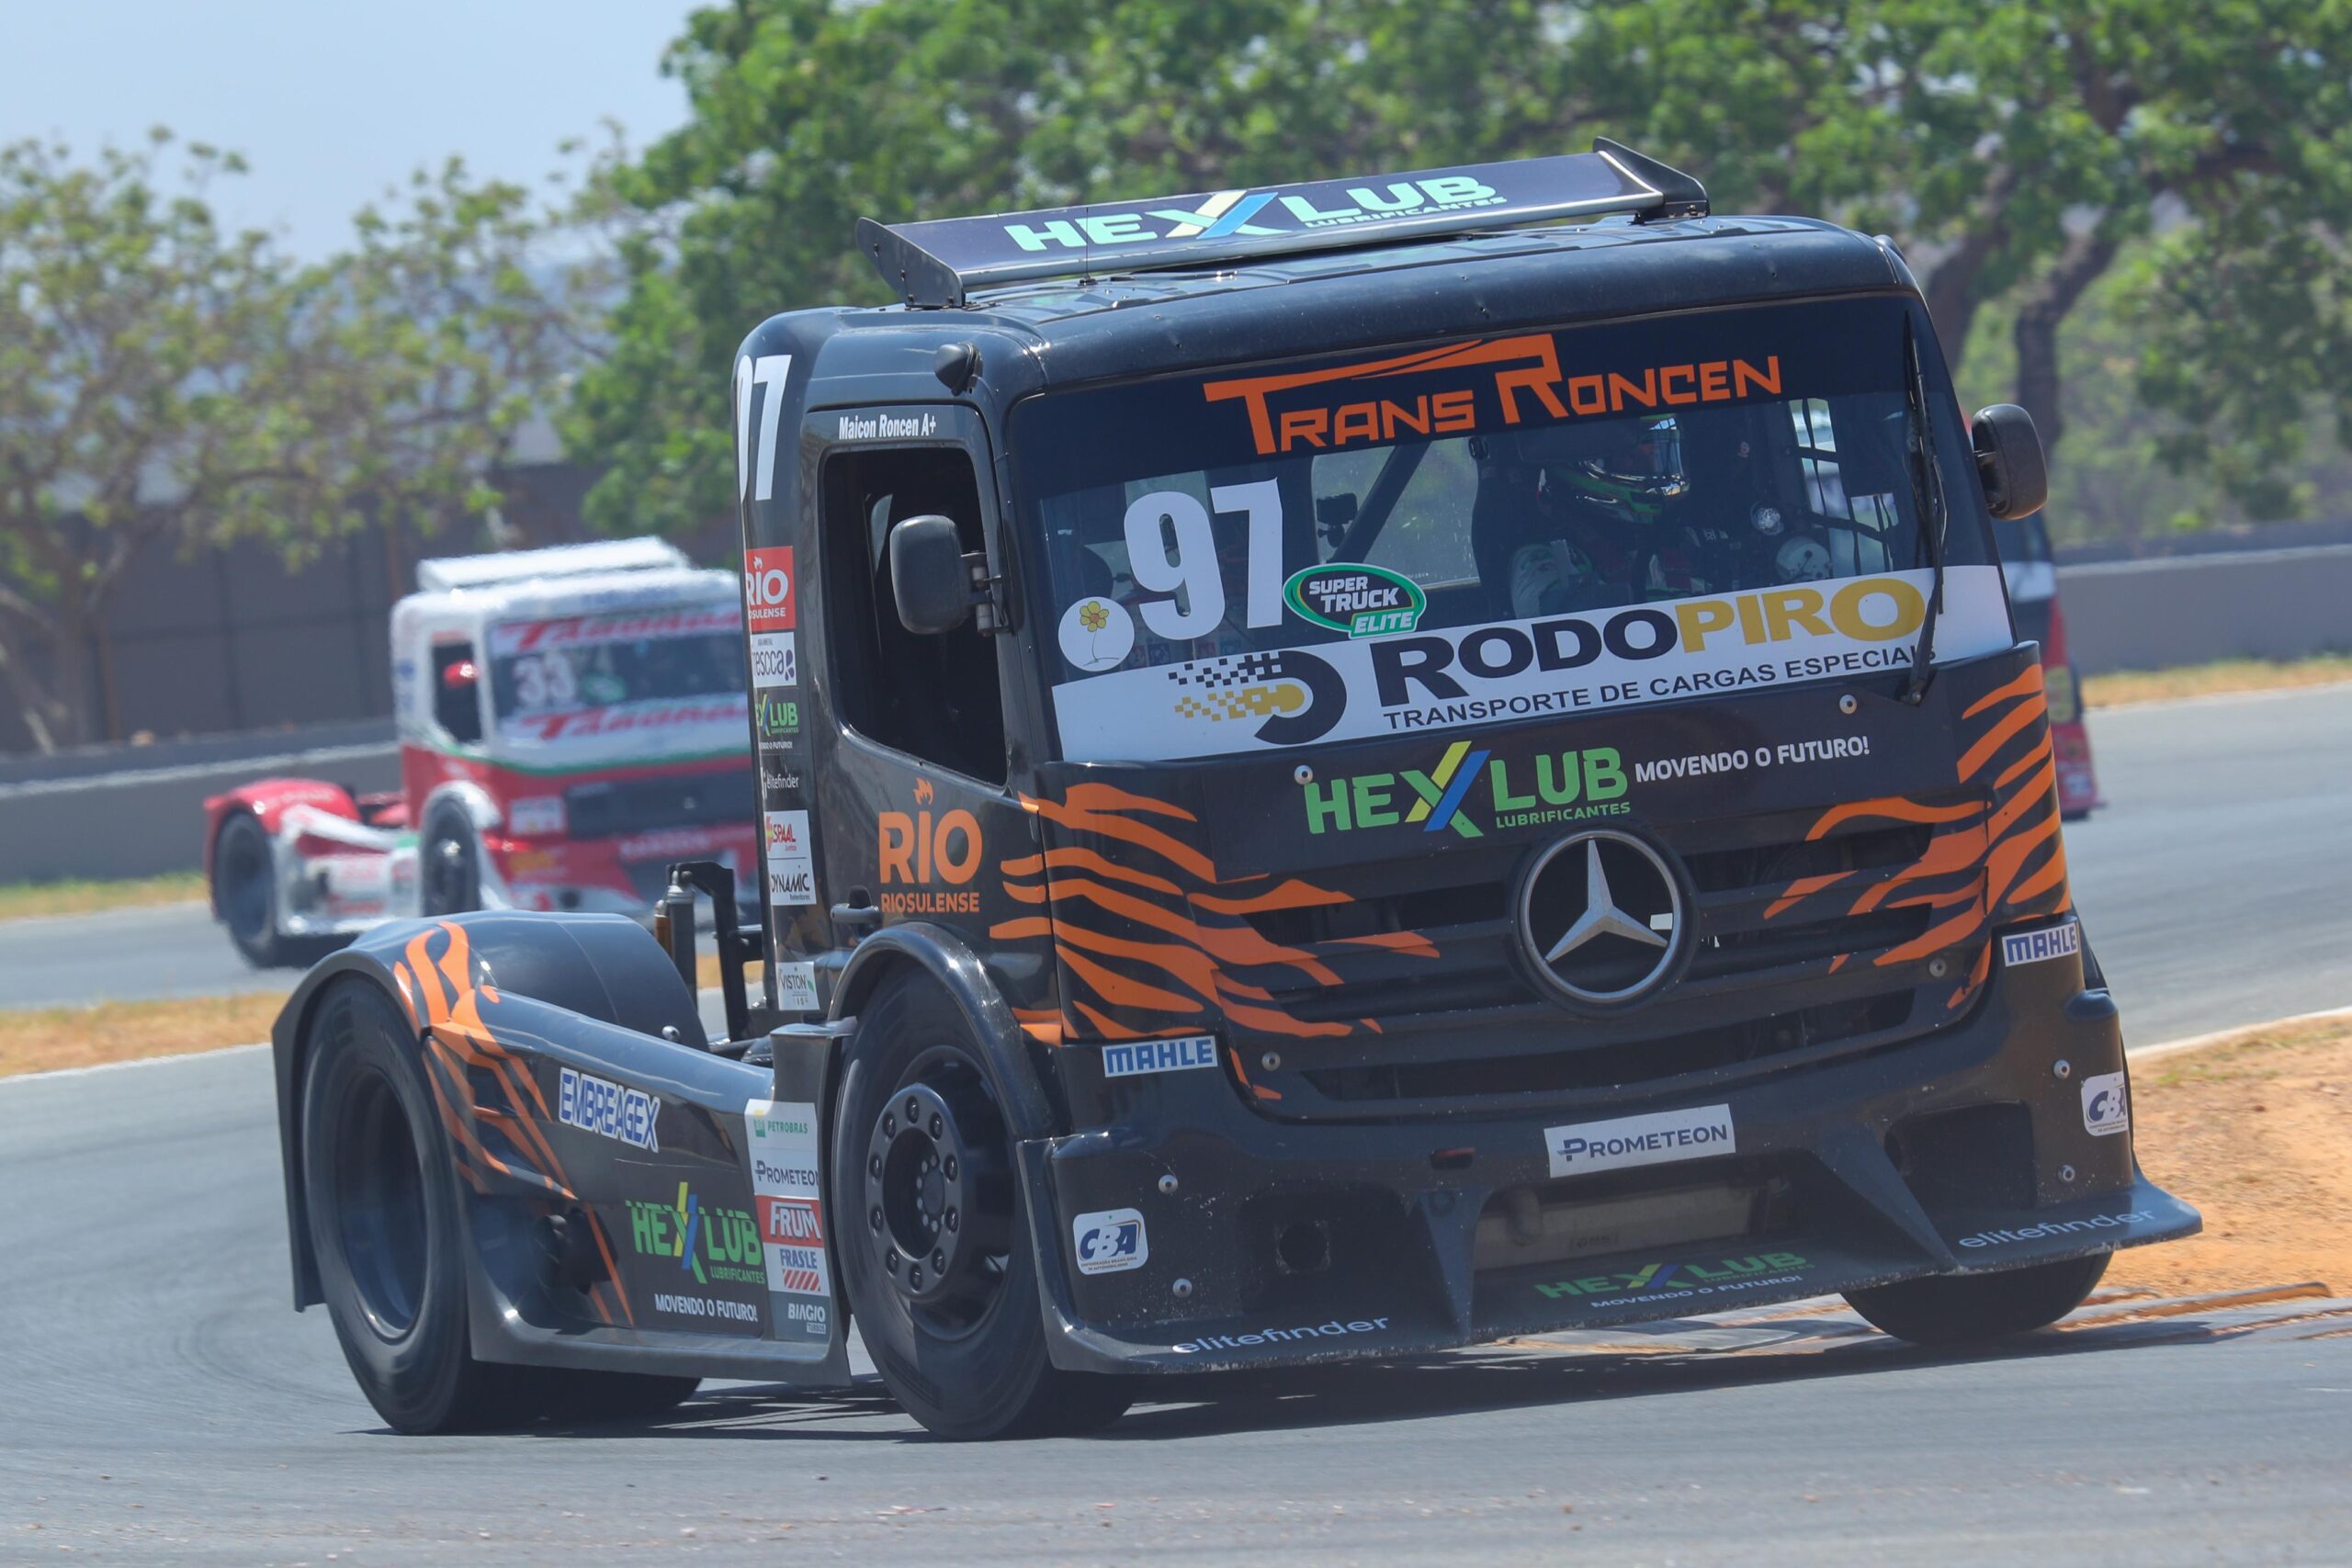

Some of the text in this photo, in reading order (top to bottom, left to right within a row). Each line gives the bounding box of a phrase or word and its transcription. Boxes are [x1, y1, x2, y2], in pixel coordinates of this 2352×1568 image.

[1004, 175, 1497, 252] HEXLUB
[1305, 197, 1508, 228] LUBRIFICANTES
[1203, 333, 1781, 455] TRANS RONCEN
[839, 412, 936, 440] Maicon Roncen A+
[1124, 478, 1283, 640] 97
[1309, 576, 1368, 595] SUPER
[1321, 587, 1399, 614] TRUCK
[1354, 611, 1414, 634] ELITE
[1370, 578, 1926, 707] RODOPIRO
[1383, 688, 1591, 729] TRANSPORTE
[1600, 682, 1640, 703] DE
[1650, 663, 1776, 695] CARGAS
[1304, 735, 1871, 838] HEXLUB MOVENDO O FUTURO!
[1496, 802, 1631, 829] LUBRIFICANTES
[878, 809, 983, 885] RIO
[880, 892, 980, 913] RIOSULENSE
[2006, 925, 2077, 963] MAHLE
[1105, 1039, 1214, 1074] MAHLE
[560, 1068, 661, 1152] EMBREAGEX
[768, 1122, 808, 1134] PETROBRAS
[1559, 1124, 1728, 1162] PROMETEON
[625, 1181, 763, 1284] HEXLUB
[770, 1201, 822, 1240] FRUM
[1959, 1209, 2156, 1247] elitefinder
[1080, 1223, 1138, 1260] CBA
[710, 1266, 765, 1284] LUBRIFICANTES
[1534, 1252, 1807, 1299] HEXLUB
[1591, 1275, 1804, 1308] MOVENDO O FUTURO!
[654, 1293, 758, 1322] MOVENDO O FUTURO!
[787, 1303, 825, 1323] BIAGIO
[1172, 1317, 1388, 1354] elitefinder
